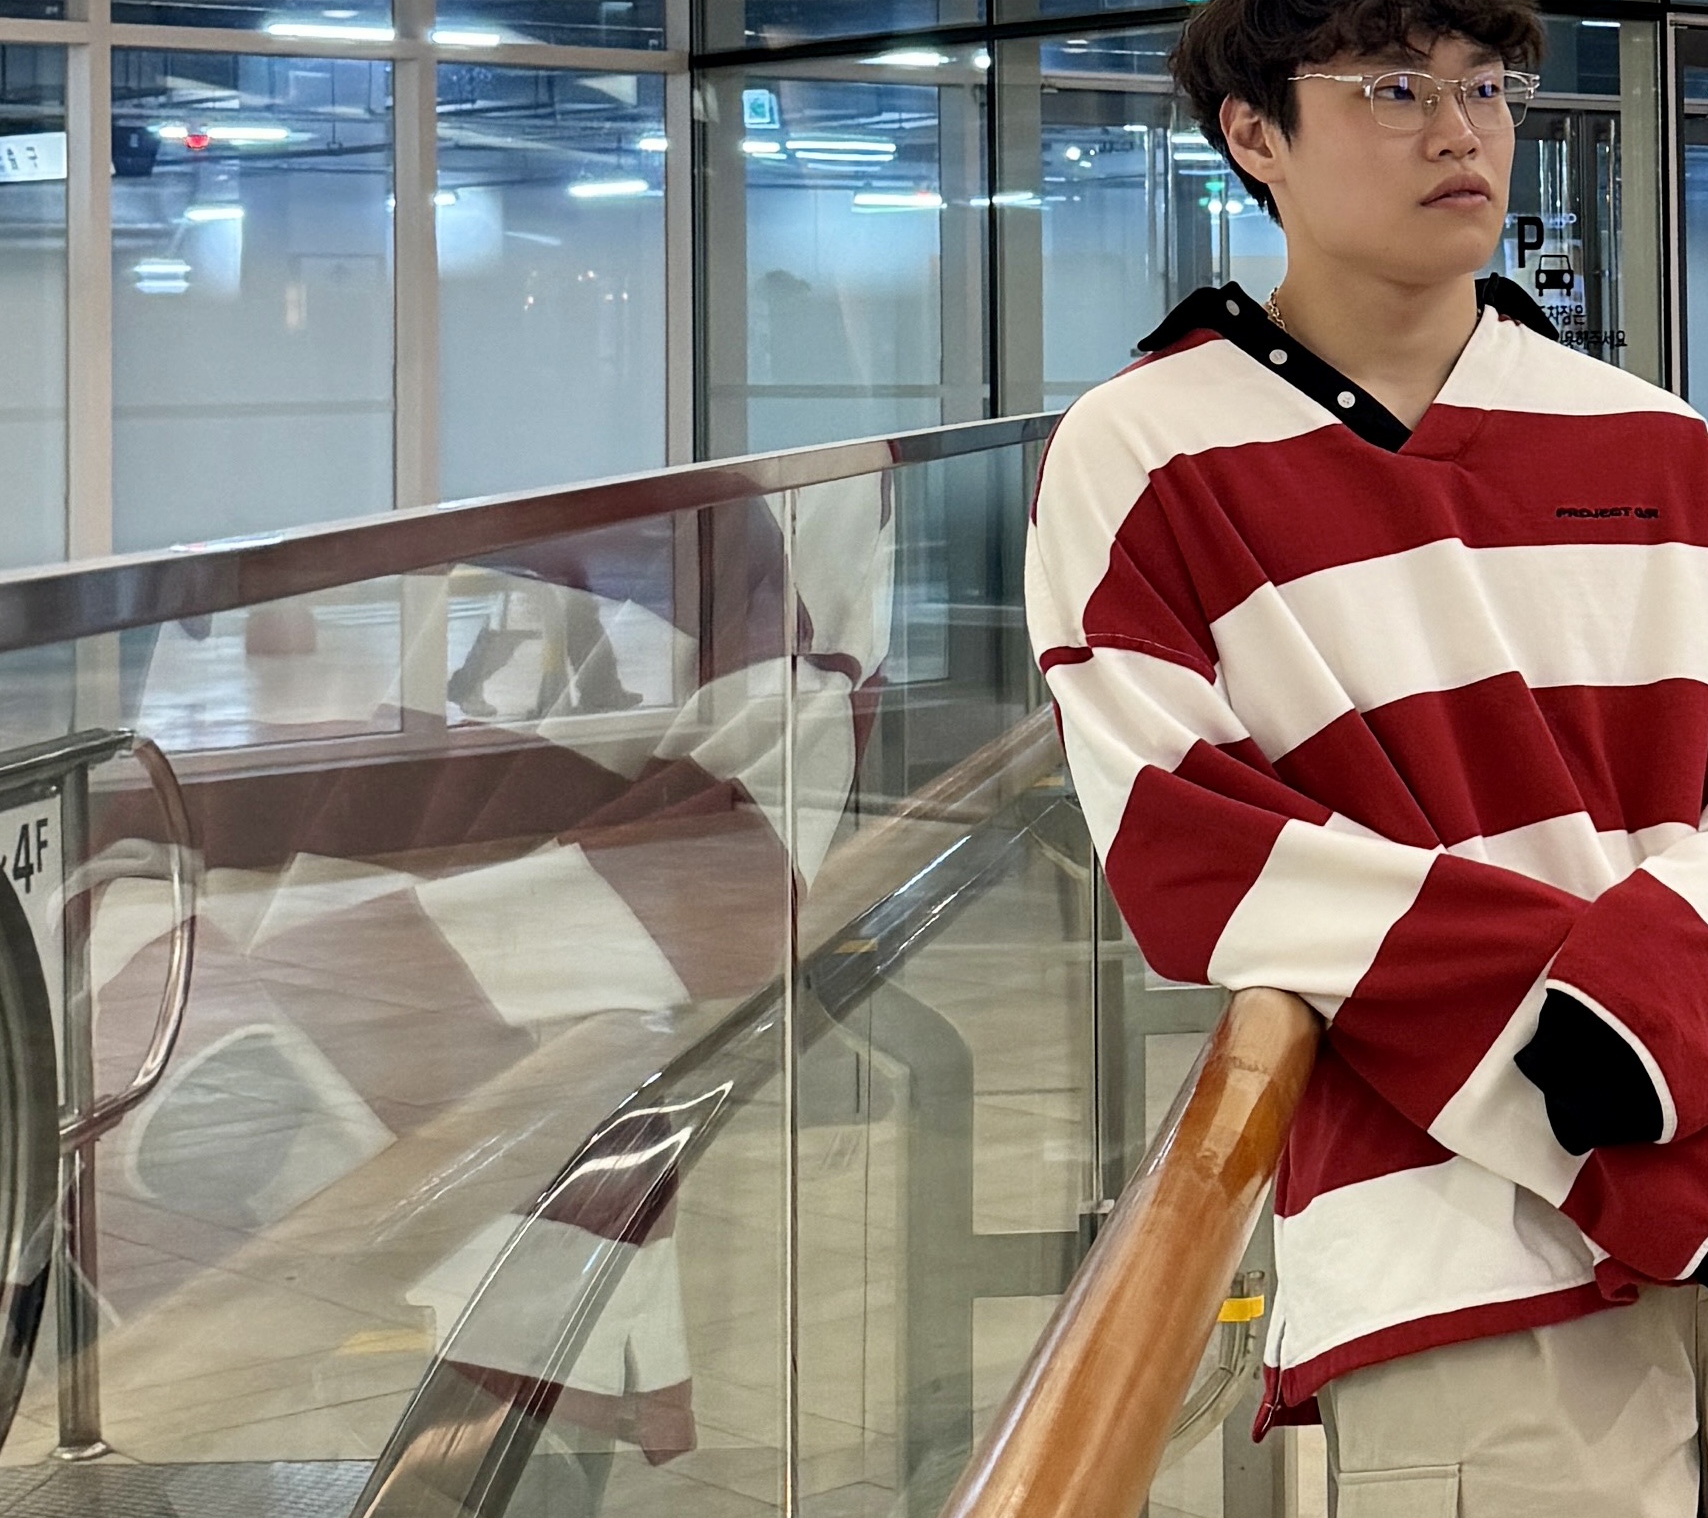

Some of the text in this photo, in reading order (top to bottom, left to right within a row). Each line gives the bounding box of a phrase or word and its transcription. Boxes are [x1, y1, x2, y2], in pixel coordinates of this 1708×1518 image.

[1517, 216, 1544, 269] P
[1540, 304, 1587, 326] 차장은
[1560, 329, 1628, 351] 용해주세요
[13, 818, 48, 894] 4F
